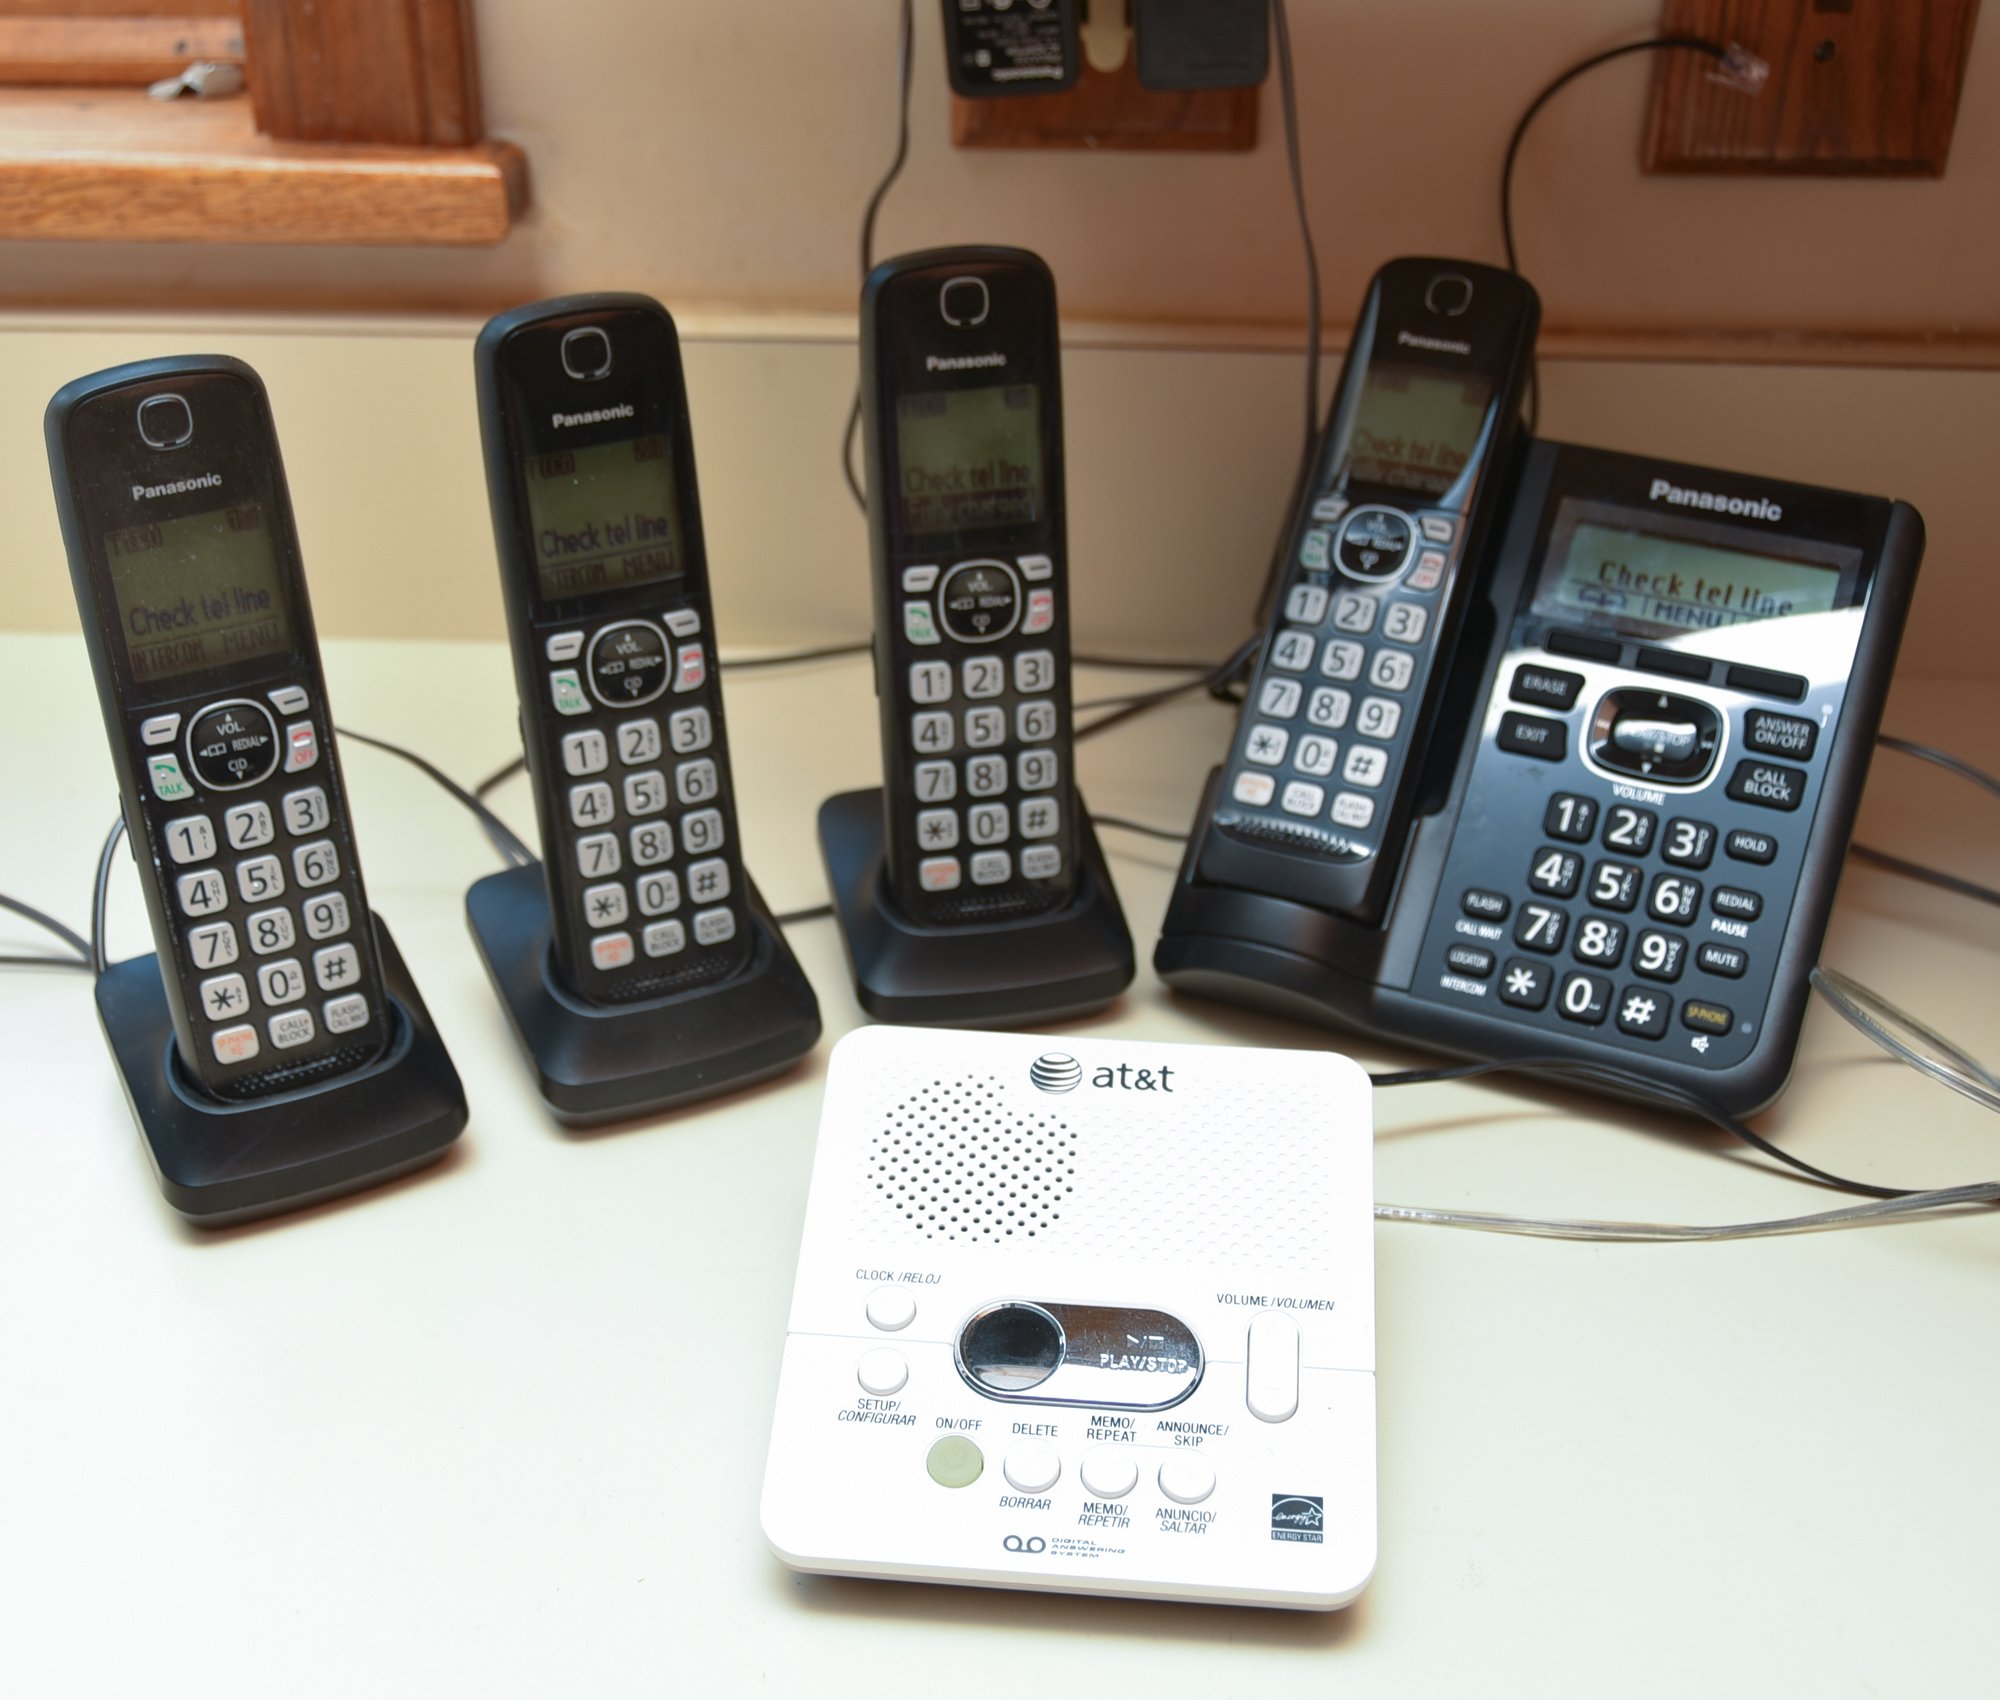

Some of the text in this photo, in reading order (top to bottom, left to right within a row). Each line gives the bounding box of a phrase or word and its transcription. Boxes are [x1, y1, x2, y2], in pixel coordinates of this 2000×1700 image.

[1398, 330, 1471, 355] Panasonic
[926, 352, 1006, 371] Panasonic
[552, 403, 634, 429] Panasonic
[132, 472, 222, 500] Panasonic
[906, 465, 966, 493] Check
[1649, 478, 1782, 522] Panasonic
[541, 513, 668, 558] Check tel line
[622, 551, 674, 581] MENU
[1599, 560, 1794, 616] Check tel line
[129, 586, 272, 636] Check tel line
[1299, 590, 1310, 617] 1
[1341, 598, 1361, 625] 2
[1655, 603, 1722, 627] MENU
[1390, 608, 1411, 635] 3
[223, 623, 279, 654] MENU
[1279, 638, 1297, 664] 4
[1328, 645, 1349, 672] 5
[1378, 655, 1397, 683] 6
[921, 670, 933, 697] 1
[971, 664, 989, 693] 2
[1023, 658, 1040, 687] 3
[1522, 674, 1568, 696] ERASE
[1270, 683, 1287, 711] 7
[1315, 694, 1334, 721] 8
[973, 713, 991, 742] 5
[1025, 708, 1042, 737] 6
[1364, 704, 1383, 732] 9
[1754, 716, 1810, 737] ANSWER
[231, 736, 260, 751] REDIAL
[626, 728, 646, 759] 2
[679, 718, 697, 747] 3
[920, 720, 938, 747] 4
[1516, 724, 1549, 743] EXIT
[1754, 728, 1807, 750] ON/OFF
[228, 758, 248, 772] CID
[295, 750, 314, 764] OFF
[574, 741, 588, 768] 1
[1303, 741, 1321, 768] 0
[684, 768, 702, 797] 6
[923, 769, 941, 797] 7
[975, 763, 993, 791] 8
[1026, 757, 1042, 785] 9
[1753, 767, 1787, 787] CALL
[158, 783, 184, 797] TALK
[633, 781, 651, 810] 5
[1612, 783, 1666, 806] VOLUME
[1743, 779, 1792, 801] BLOCK
[293, 798, 314, 828] 3
[579, 792, 599, 820] 4
[1558, 797, 1575, 832] 1
[235, 813, 258, 844] 2
[691, 820, 708, 848] 9
[977, 811, 995, 839] 0
[1608, 808, 1638, 846] 2
[179, 827, 194, 857] 1
[639, 832, 658, 860] 8
[1668, 822, 1697, 857] 3
[1735, 835, 1767, 853] HOLD
[304, 851, 324, 881] 6
[586, 843, 604, 872] 7
[1534, 853, 1563, 887] 4
[248, 865, 267, 896] 5
[1594, 864, 1623, 900] 5
[190, 880, 211, 909] 4
[646, 881, 664, 909] 0
[1467, 893, 1503, 912] FLASH
[1654, 879, 1680, 914] 6
[1717, 891, 1754, 911] REDIAL
[314, 904, 334, 933] 9
[1455, 919, 1503, 941] CALL WAIT
[1524, 906, 1550, 941] 7
[1711, 918, 1749, 938] PAUSE
[257, 919, 279, 948] 8
[1579, 920, 1608, 956] 8
[199, 932, 219, 963] 7
[1450, 949, 1489, 969] LOCATOR
[1639, 934, 1667, 970] 9
[1705, 949, 1739, 968] MUTE
[269, 970, 289, 999] 0
[1440, 974, 1487, 997] INTERCOM
[1565, 977, 1593, 1013] 0
[278, 1029, 311, 1044] BLOCK
[279, 1020, 304, 1033] CALL
[1092, 1063, 1175, 1093] at&t
[856, 1269, 942, 1285] CLOCK /RELOJ
[1217, 1293, 1335, 1311] VOLUME /VOLUMEN
[1100, 1353, 1188, 1374] PLAY/STOP
[838, 1410, 916, 1426] CONFIGURAR
[857, 1398, 901, 1412] SETUP/
[935, 1417, 983, 1431] ON/OFF
[1012, 1422, 1059, 1437] DELETE
[1086, 1428, 1137, 1442] REPEAT
[1091, 1415, 1136, 1429] MEMO/
[1156, 1421, 1230, 1436] ANNOUNCE/
[1174, 1435, 1204, 1447] SKIP
[999, 1496, 1052, 1511] BORRAR
[1083, 1502, 1129, 1516] MEMO/
[1155, 1508, 1217, 1523] ANUNCIO/
[1078, 1514, 1131, 1529] REPETIR
[1159, 1520, 1207, 1535] SALTAR
[1051, 1537, 1097, 1546] DIGITAL
[1051, 1544, 1126, 1554] ANSWERING
[1272, 1531, 1322, 1542] ENERGY STAR
